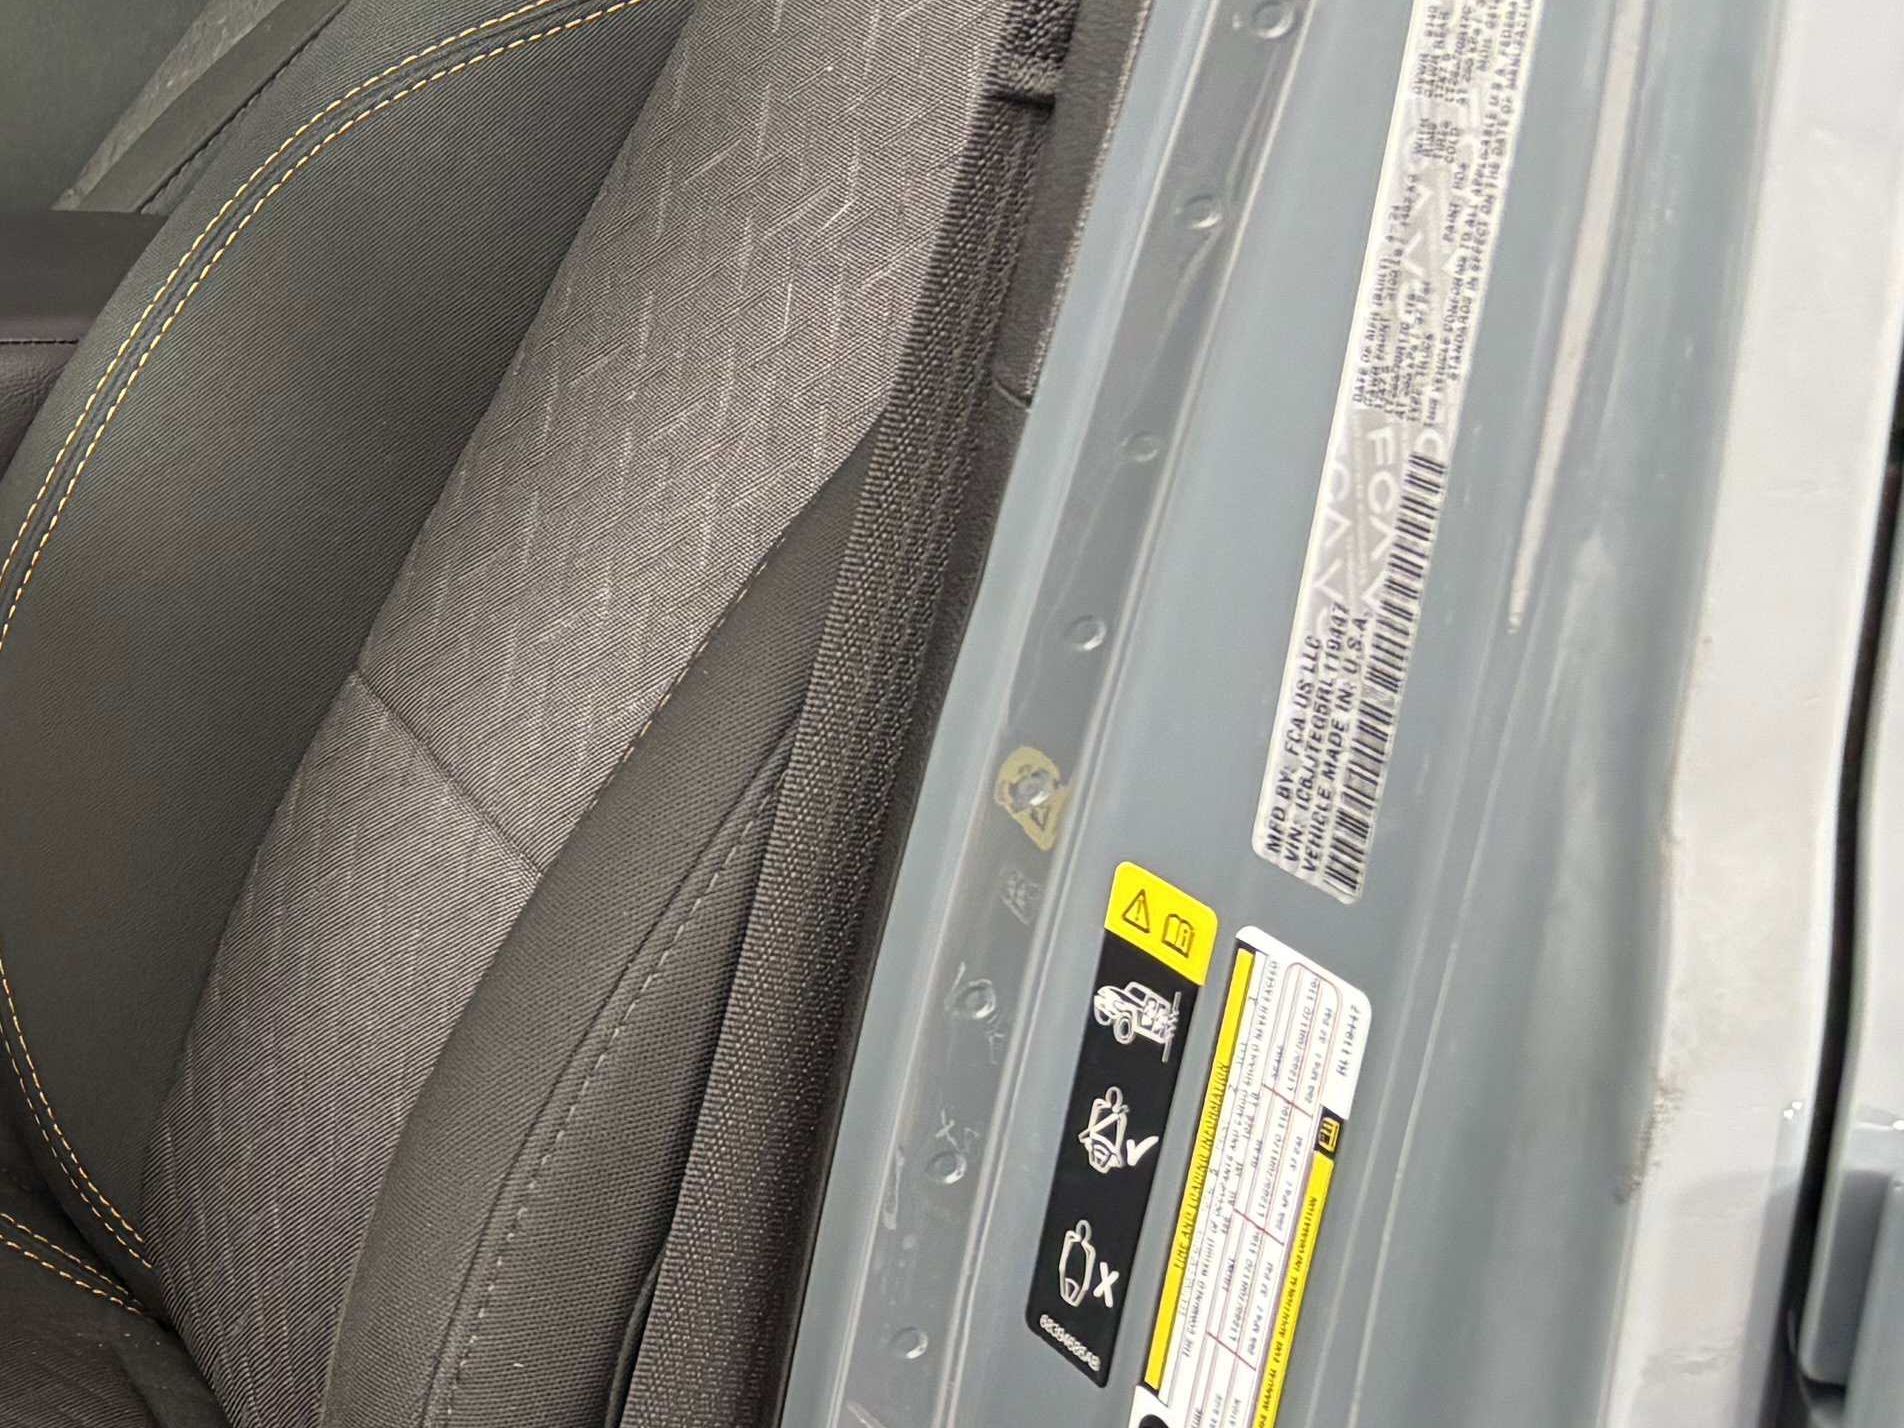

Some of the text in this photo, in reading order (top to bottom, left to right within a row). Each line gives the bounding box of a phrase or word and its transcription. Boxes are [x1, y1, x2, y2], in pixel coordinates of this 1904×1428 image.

[1300, 634, 1320, 673] LLC
[1293, 677, 1311, 708] US
[1284, 715, 1304, 755] FCA
[1303, 787, 1331, 873] VEHICLE
[1321, 718, 1345, 780] MADE
[1265, 805, 1287, 854] MFD
